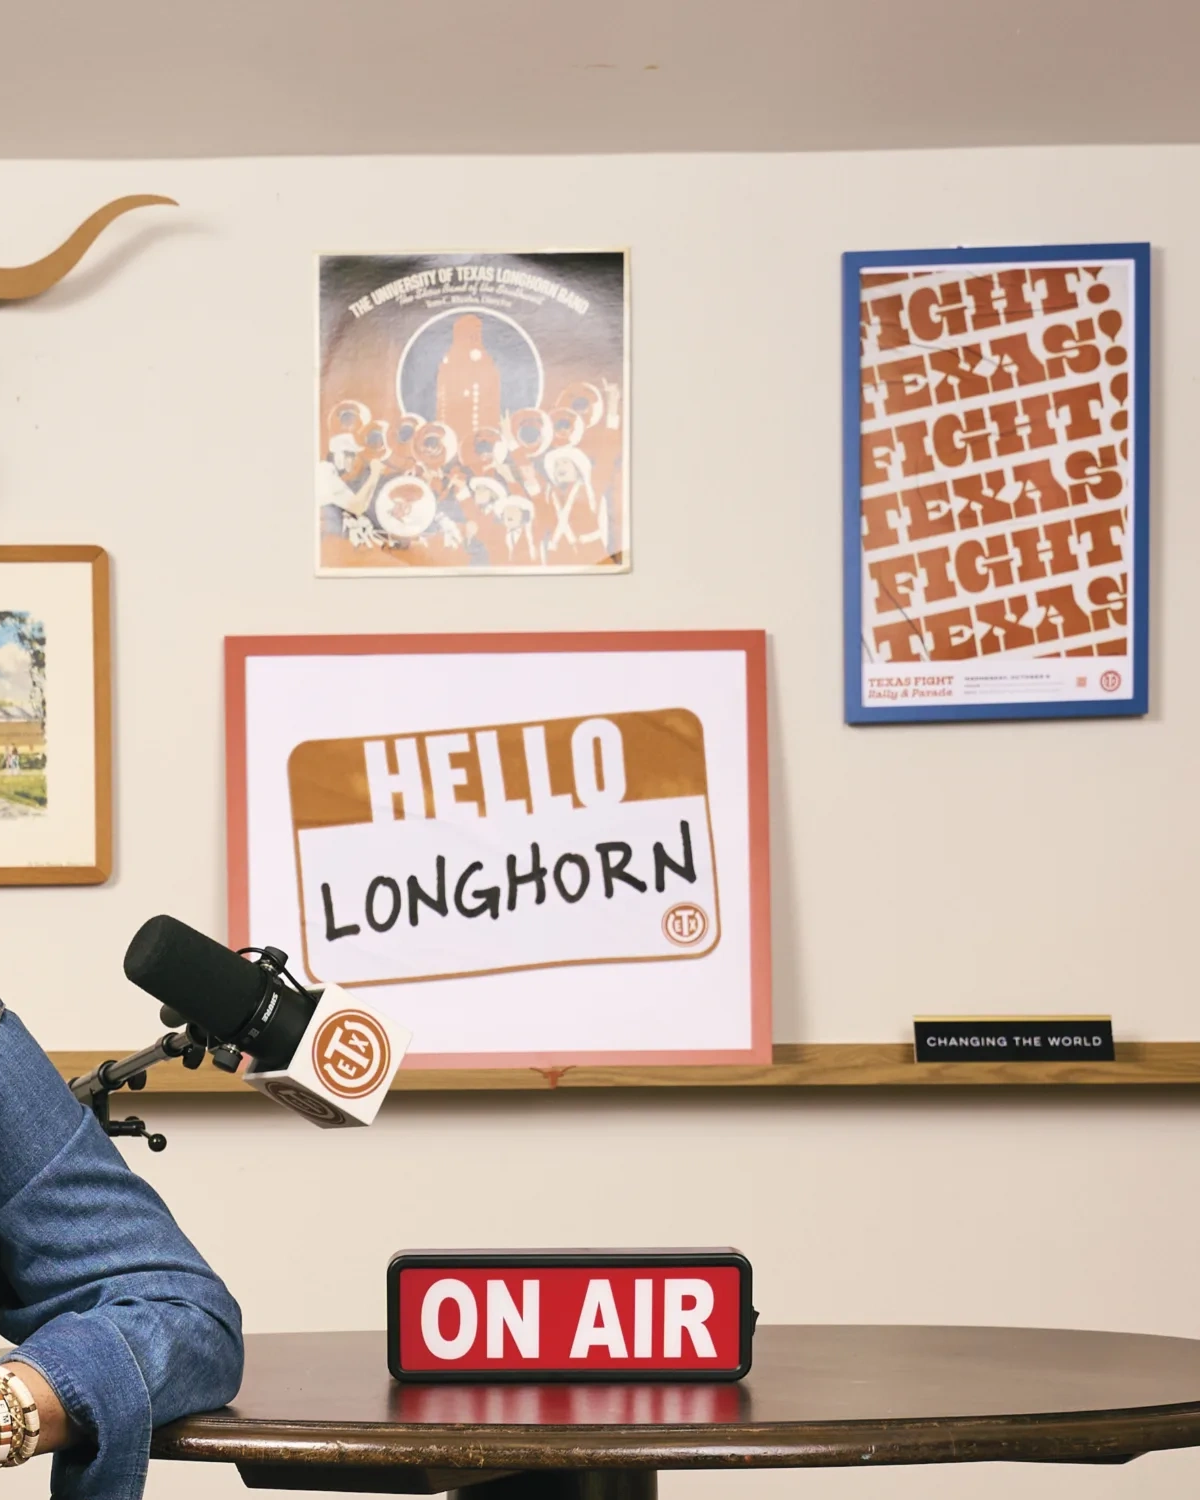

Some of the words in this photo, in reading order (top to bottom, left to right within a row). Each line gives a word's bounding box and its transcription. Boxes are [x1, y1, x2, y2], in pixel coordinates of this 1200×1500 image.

[348, 295, 374, 318] THE
[370, 269, 438, 305] UNIVERSITY
[438, 267, 454, 283] OF
[455, 266, 494, 282] TEXAS
[496, 268, 560, 299] LONGHORN
[556, 287, 590, 316] BAND
[861, 267, 1110, 356] IGHT!
[868, 677, 911, 688] TEXAS
[914, 675, 954, 686] FIGHT
[912, 687, 953, 698] Parade
[363, 718, 627, 823] HELLO
[321, 819, 697, 942] LONGHORN
[261, 991, 279, 1023] SHURE
[926, 1036, 1008, 1047] CHANGING
[1013, 1036, 1042, 1047] THE
[1047, 1035, 1103, 1047] WORLD
[420, 1278, 540, 1360] ON
[568, 1278, 718, 1358] AIR
